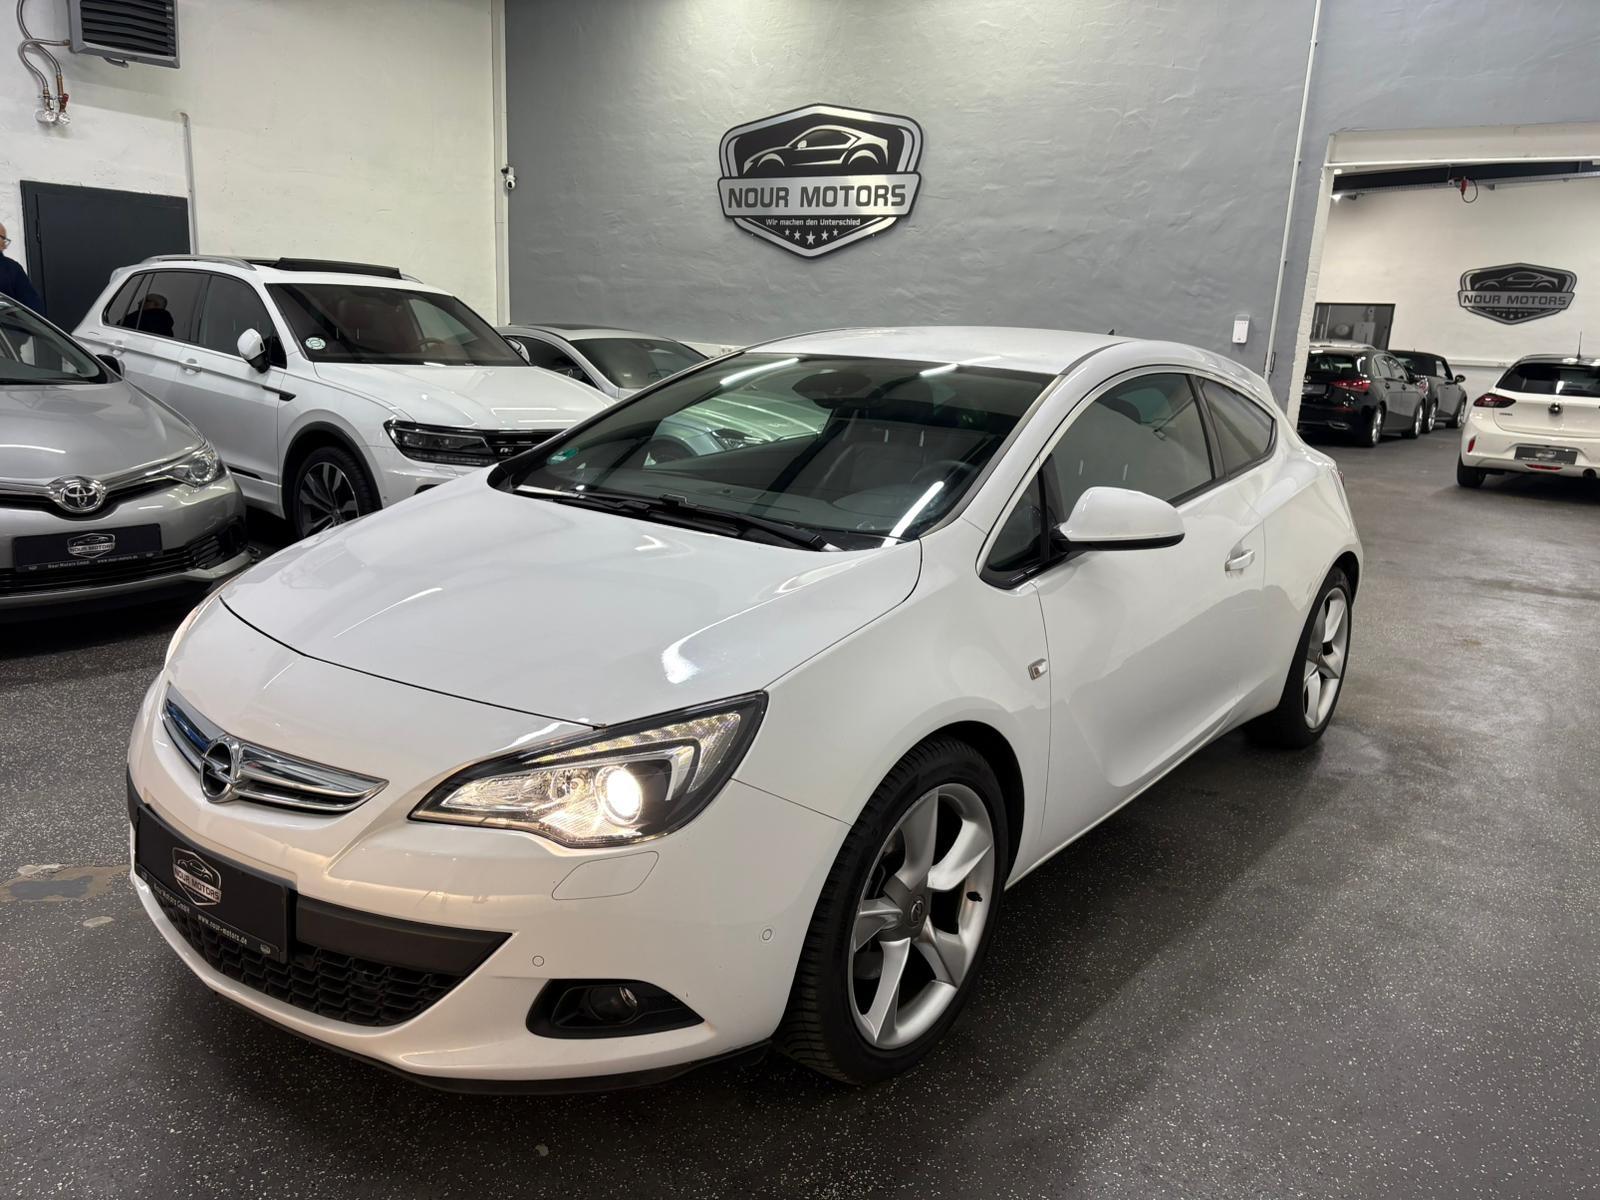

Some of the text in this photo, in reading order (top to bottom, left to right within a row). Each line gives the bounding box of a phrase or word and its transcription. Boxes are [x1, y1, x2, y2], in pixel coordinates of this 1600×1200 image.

[728, 184, 906, 208] NOUR MOTORS
[766, 218, 861, 226] Wir machen den Unterschied
[1463, 294, 1567, 306] NOUR MOTORS
[191, 879, 220, 901] MOTORS
